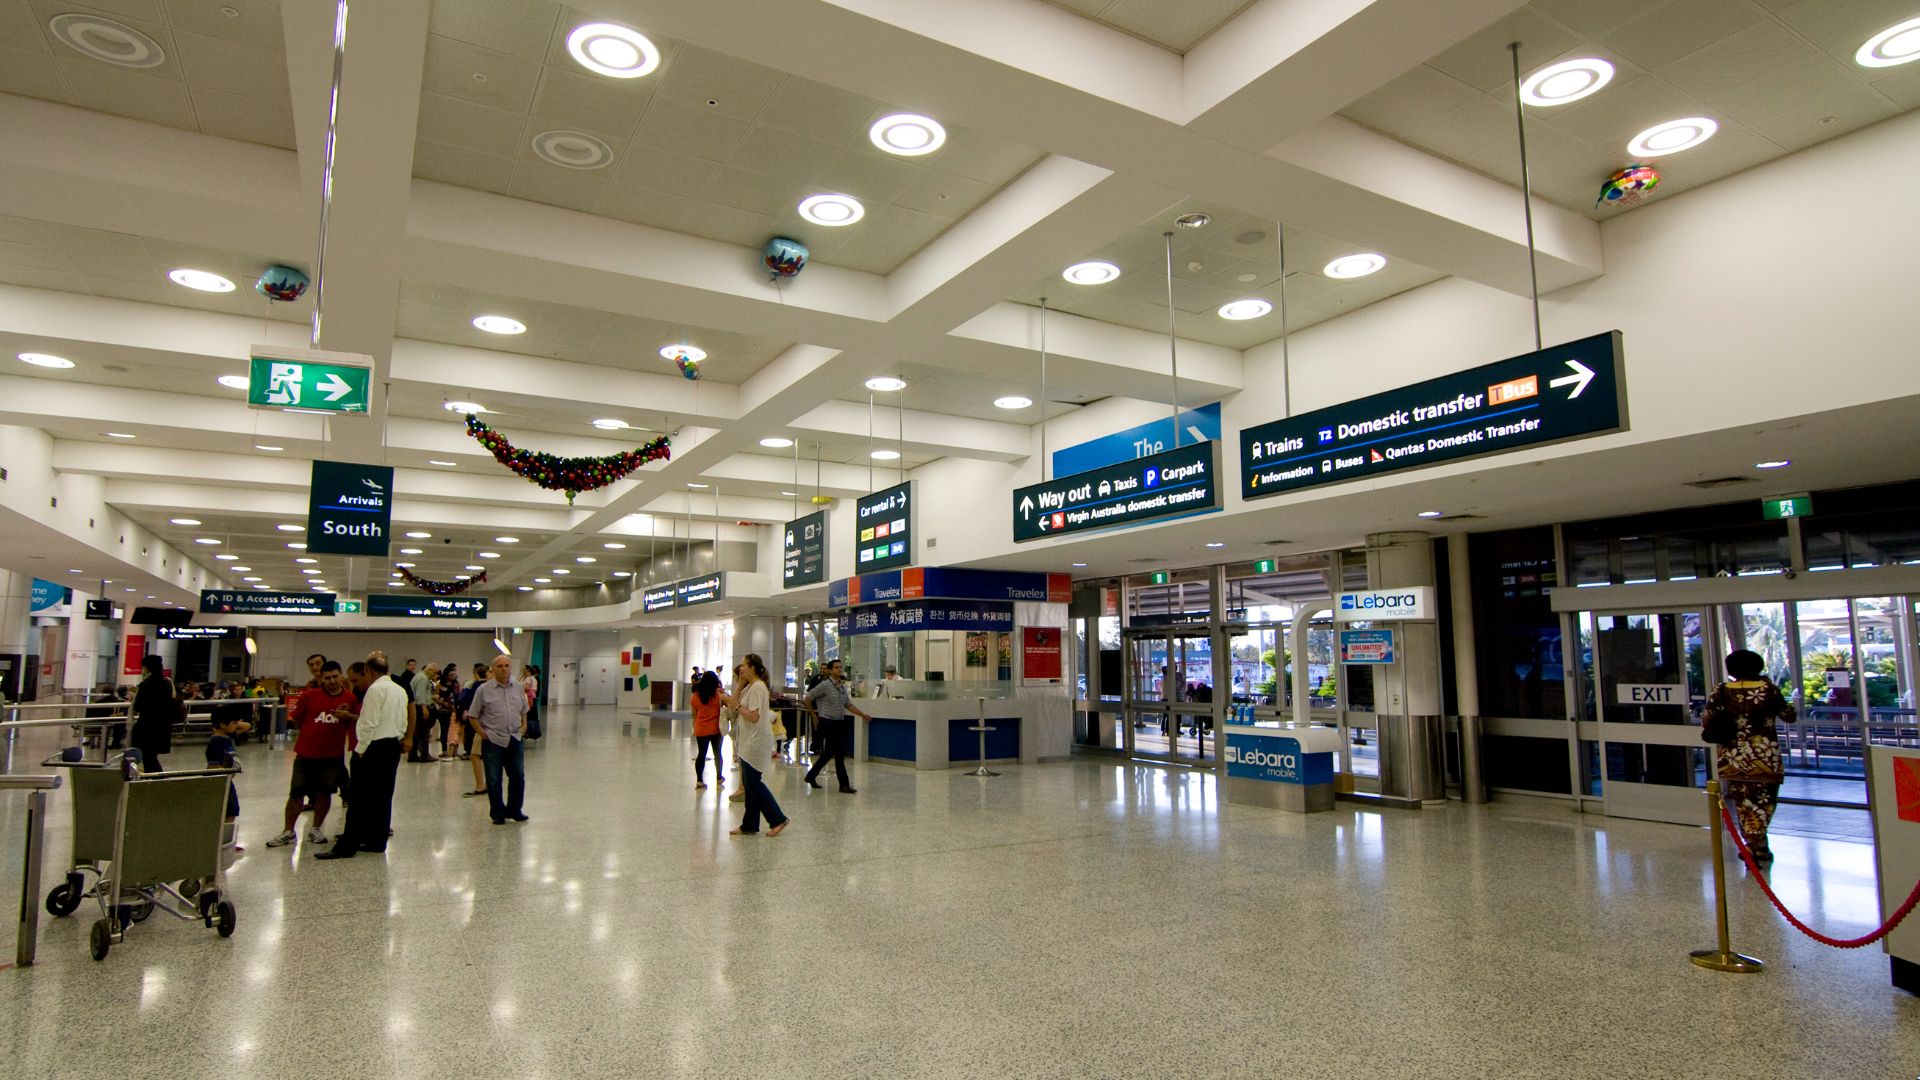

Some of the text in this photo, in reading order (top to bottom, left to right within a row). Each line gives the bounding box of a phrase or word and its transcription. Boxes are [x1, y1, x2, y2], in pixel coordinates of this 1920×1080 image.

[1319, 380, 1535, 442] T2 Domestic transfer TBus
[1265, 436, 1303, 456] Trains
[1385, 418, 1540, 460] Qantas Domestic Transfer
[1133, 438, 1164, 459] The
[1335, 455, 1364, 469] Buses
[1146, 461, 1204, 486] P Carpark
[1261, 466, 1313, 484] Information
[1113, 476, 1137, 492] Taxis
[339, 495, 383, 506] Arrivals
[1038, 484, 1091, 509] Way out
[861, 498, 888, 517] Car rental
[1067, 488, 1206, 524] Virgin Australia domestic transfer
[323, 520, 382, 537] South
[246, 595, 278, 603] Access
[280, 596, 315, 604] Service
[874, 587, 900, 599] Travelex
[1006, 587, 1045, 598] Travelex
[433, 600, 453, 609] Way
[1355, 593, 1416, 610] Lebara
[929, 610, 945, 620] 환전
[1386, 608, 1416, 616] mobile
[1632, 687, 1672, 702] EXIT
[1237, 749, 1296, 768] Lebara
[1267, 768, 1296, 778] mobile
